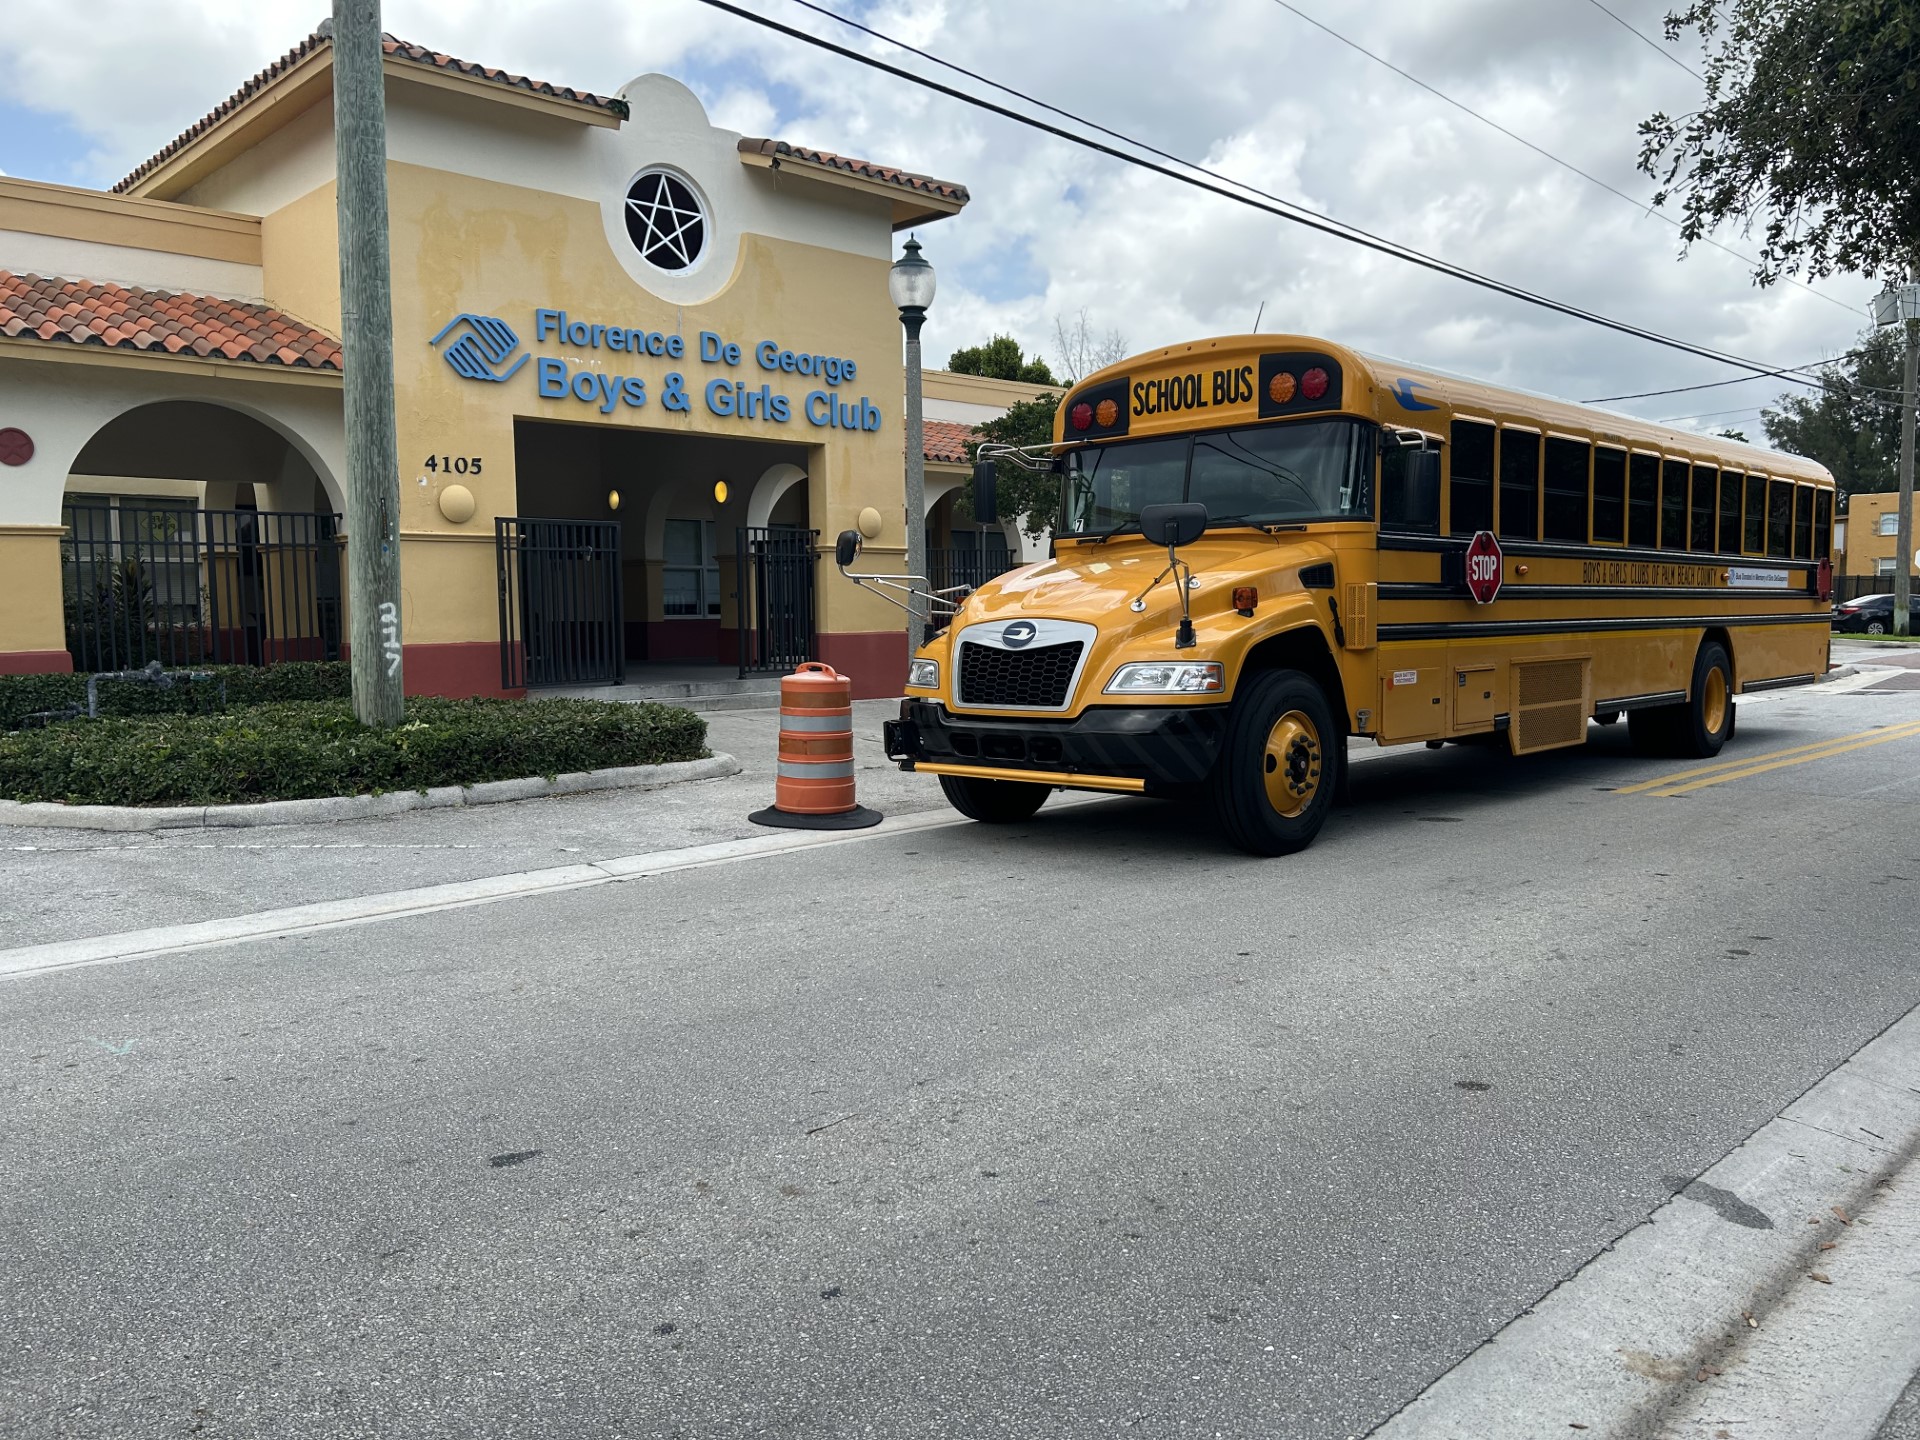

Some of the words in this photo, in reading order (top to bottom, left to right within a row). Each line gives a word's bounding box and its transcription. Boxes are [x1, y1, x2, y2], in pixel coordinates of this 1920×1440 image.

[536, 308, 685, 358] Florence
[699, 331, 741, 366] De
[755, 340, 857, 386] George
[537, 357, 647, 413] Boys
[661, 372, 691, 412] &
[705, 378, 791, 422] Girls
[805, 390, 881, 432] Club
[1132, 373, 1209, 416] SCHOOL
[1212, 365, 1253, 405] BUS
[424, 454, 482, 474] 4105
[1076, 520, 1083, 532] 7
[1472, 555, 1497, 581] STOP
[1583, 562, 1600, 584] BOYS
[1609, 563, 1627, 584] GIRLS
[1630, 563, 1649, 584] CLUBS
[1652, 564, 1660, 585] OF
[1662, 564, 1675, 585] PALM
[1677, 565, 1694, 585] BEACH
[1697, 566, 1717, 586] COUNTY
